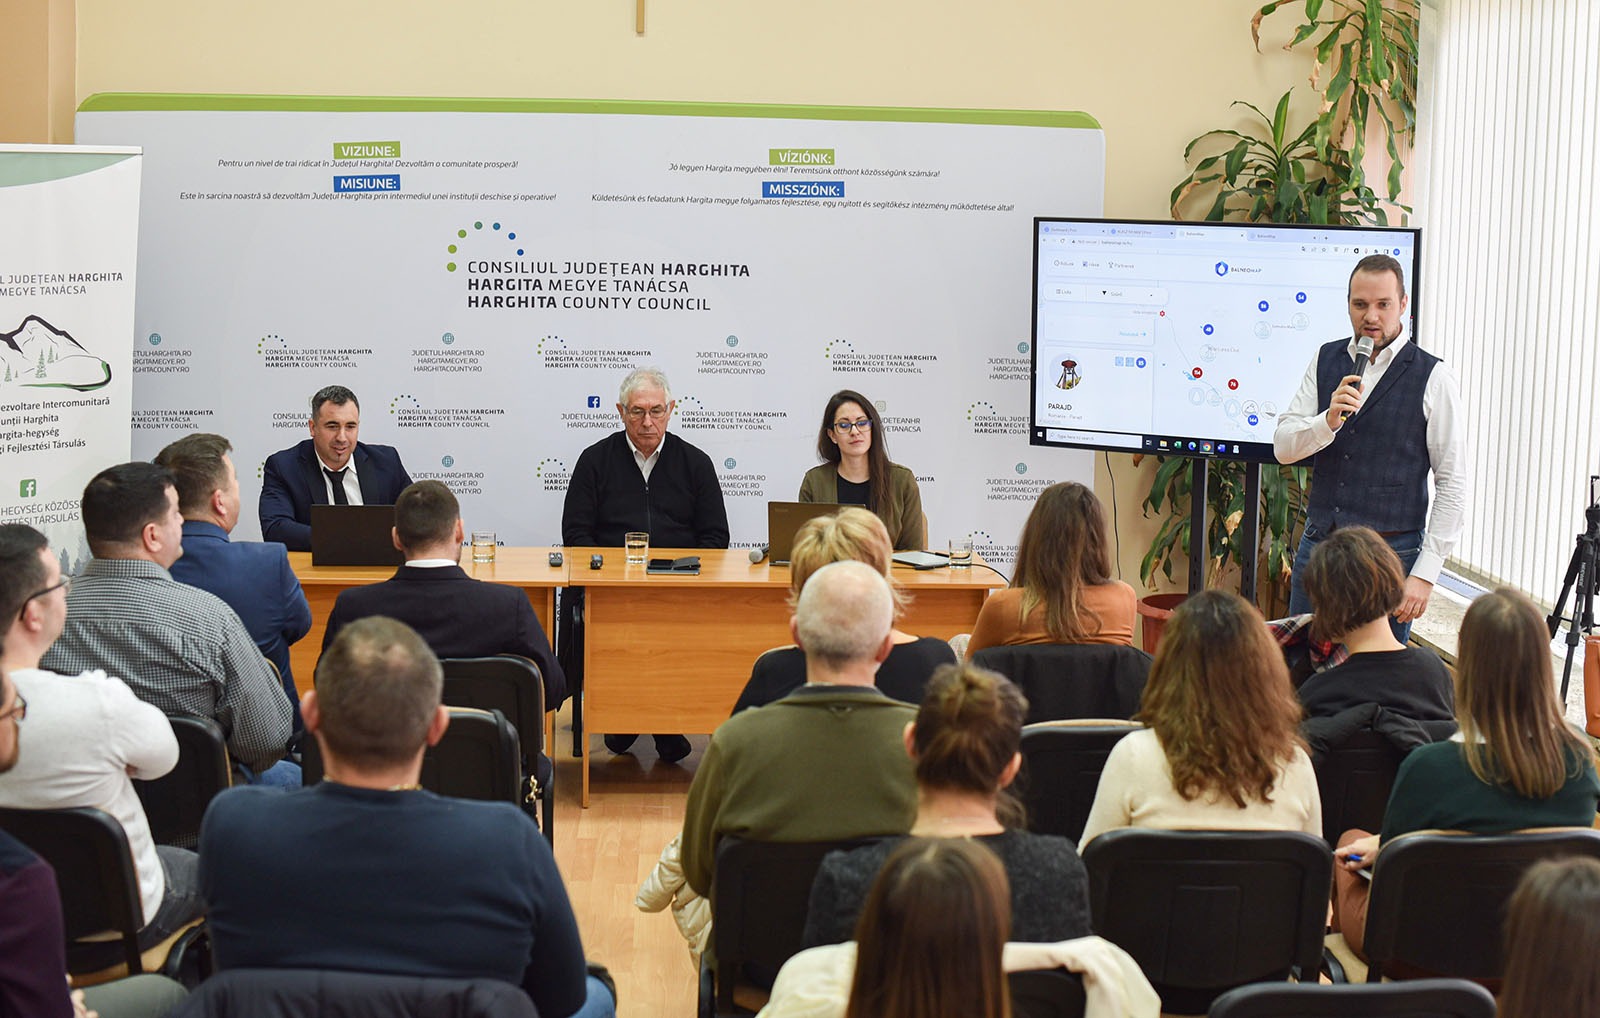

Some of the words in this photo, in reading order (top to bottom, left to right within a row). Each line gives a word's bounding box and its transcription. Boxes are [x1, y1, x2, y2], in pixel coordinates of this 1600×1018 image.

[341, 146, 395, 157] VIZIUNE:
[779, 150, 831, 164] VÍZIÓNK:
[360, 160, 394, 169] Harghita!
[395, 160, 434, 168] Dezvoltăm
[669, 163, 678, 171] Jó
[680, 164, 704, 173] legyen
[705, 165, 732, 174] Hargita
[734, 166, 771, 174] megyében
[773, 166, 788, 174] élni!
[790, 167, 831, 175] Teremtsünk
[861, 168, 907, 177] közösségünk
[340, 178, 397, 189] MISIUNE:
[769, 183, 840, 196] MISSZIÓNK:
[180, 192, 197, 200] Este
[272, 192, 310, 200] dezvoltăm
[341, 193, 372, 202] Harghita
[374, 193, 388, 202] prin
[390, 193, 431, 201] intermediul
[520, 194, 557, 202] operative!
[592, 194, 636, 202] Küldetésünk
[686, 196, 713, 205] Hargita
[714, 198, 739, 206] megye
[740, 197, 781, 206] folyamatos
[837, 200, 861, 208] nyitott
[911, 202, 949, 211] intézmény
[468, 261, 558, 274] CONSILIUL
[563, 262, 654, 277] JUDEȚEAN
[662, 263, 750, 277] HARGHITA
[68, 272, 123, 282] HARGHITA
[0, 287, 36, 297] MEGYE
[40, 284, 87, 295] TANÁCSA
[468, 278, 543, 291] HARGITA
[548, 280, 607, 292] MEGYE
[613, 277, 689, 293] TANÁCSA
[468, 296, 557, 308] HARGHITA
[563, 296, 632, 309] COUNTY
[638, 298, 711, 310] COUNCIL
[1, 402, 40, 412] ezvoltare
[42, 397, 110, 409] Intercomunitară
[1, 416, 21, 426] unții
[23, 414, 59, 425] Harghita
[0, 427, 60, 441] argita-hegység
[7, 442, 50, 454] Fejlesztési
[52, 439, 86, 449] Társulás
[34, 510, 80, 525] TÁRSULÁS
